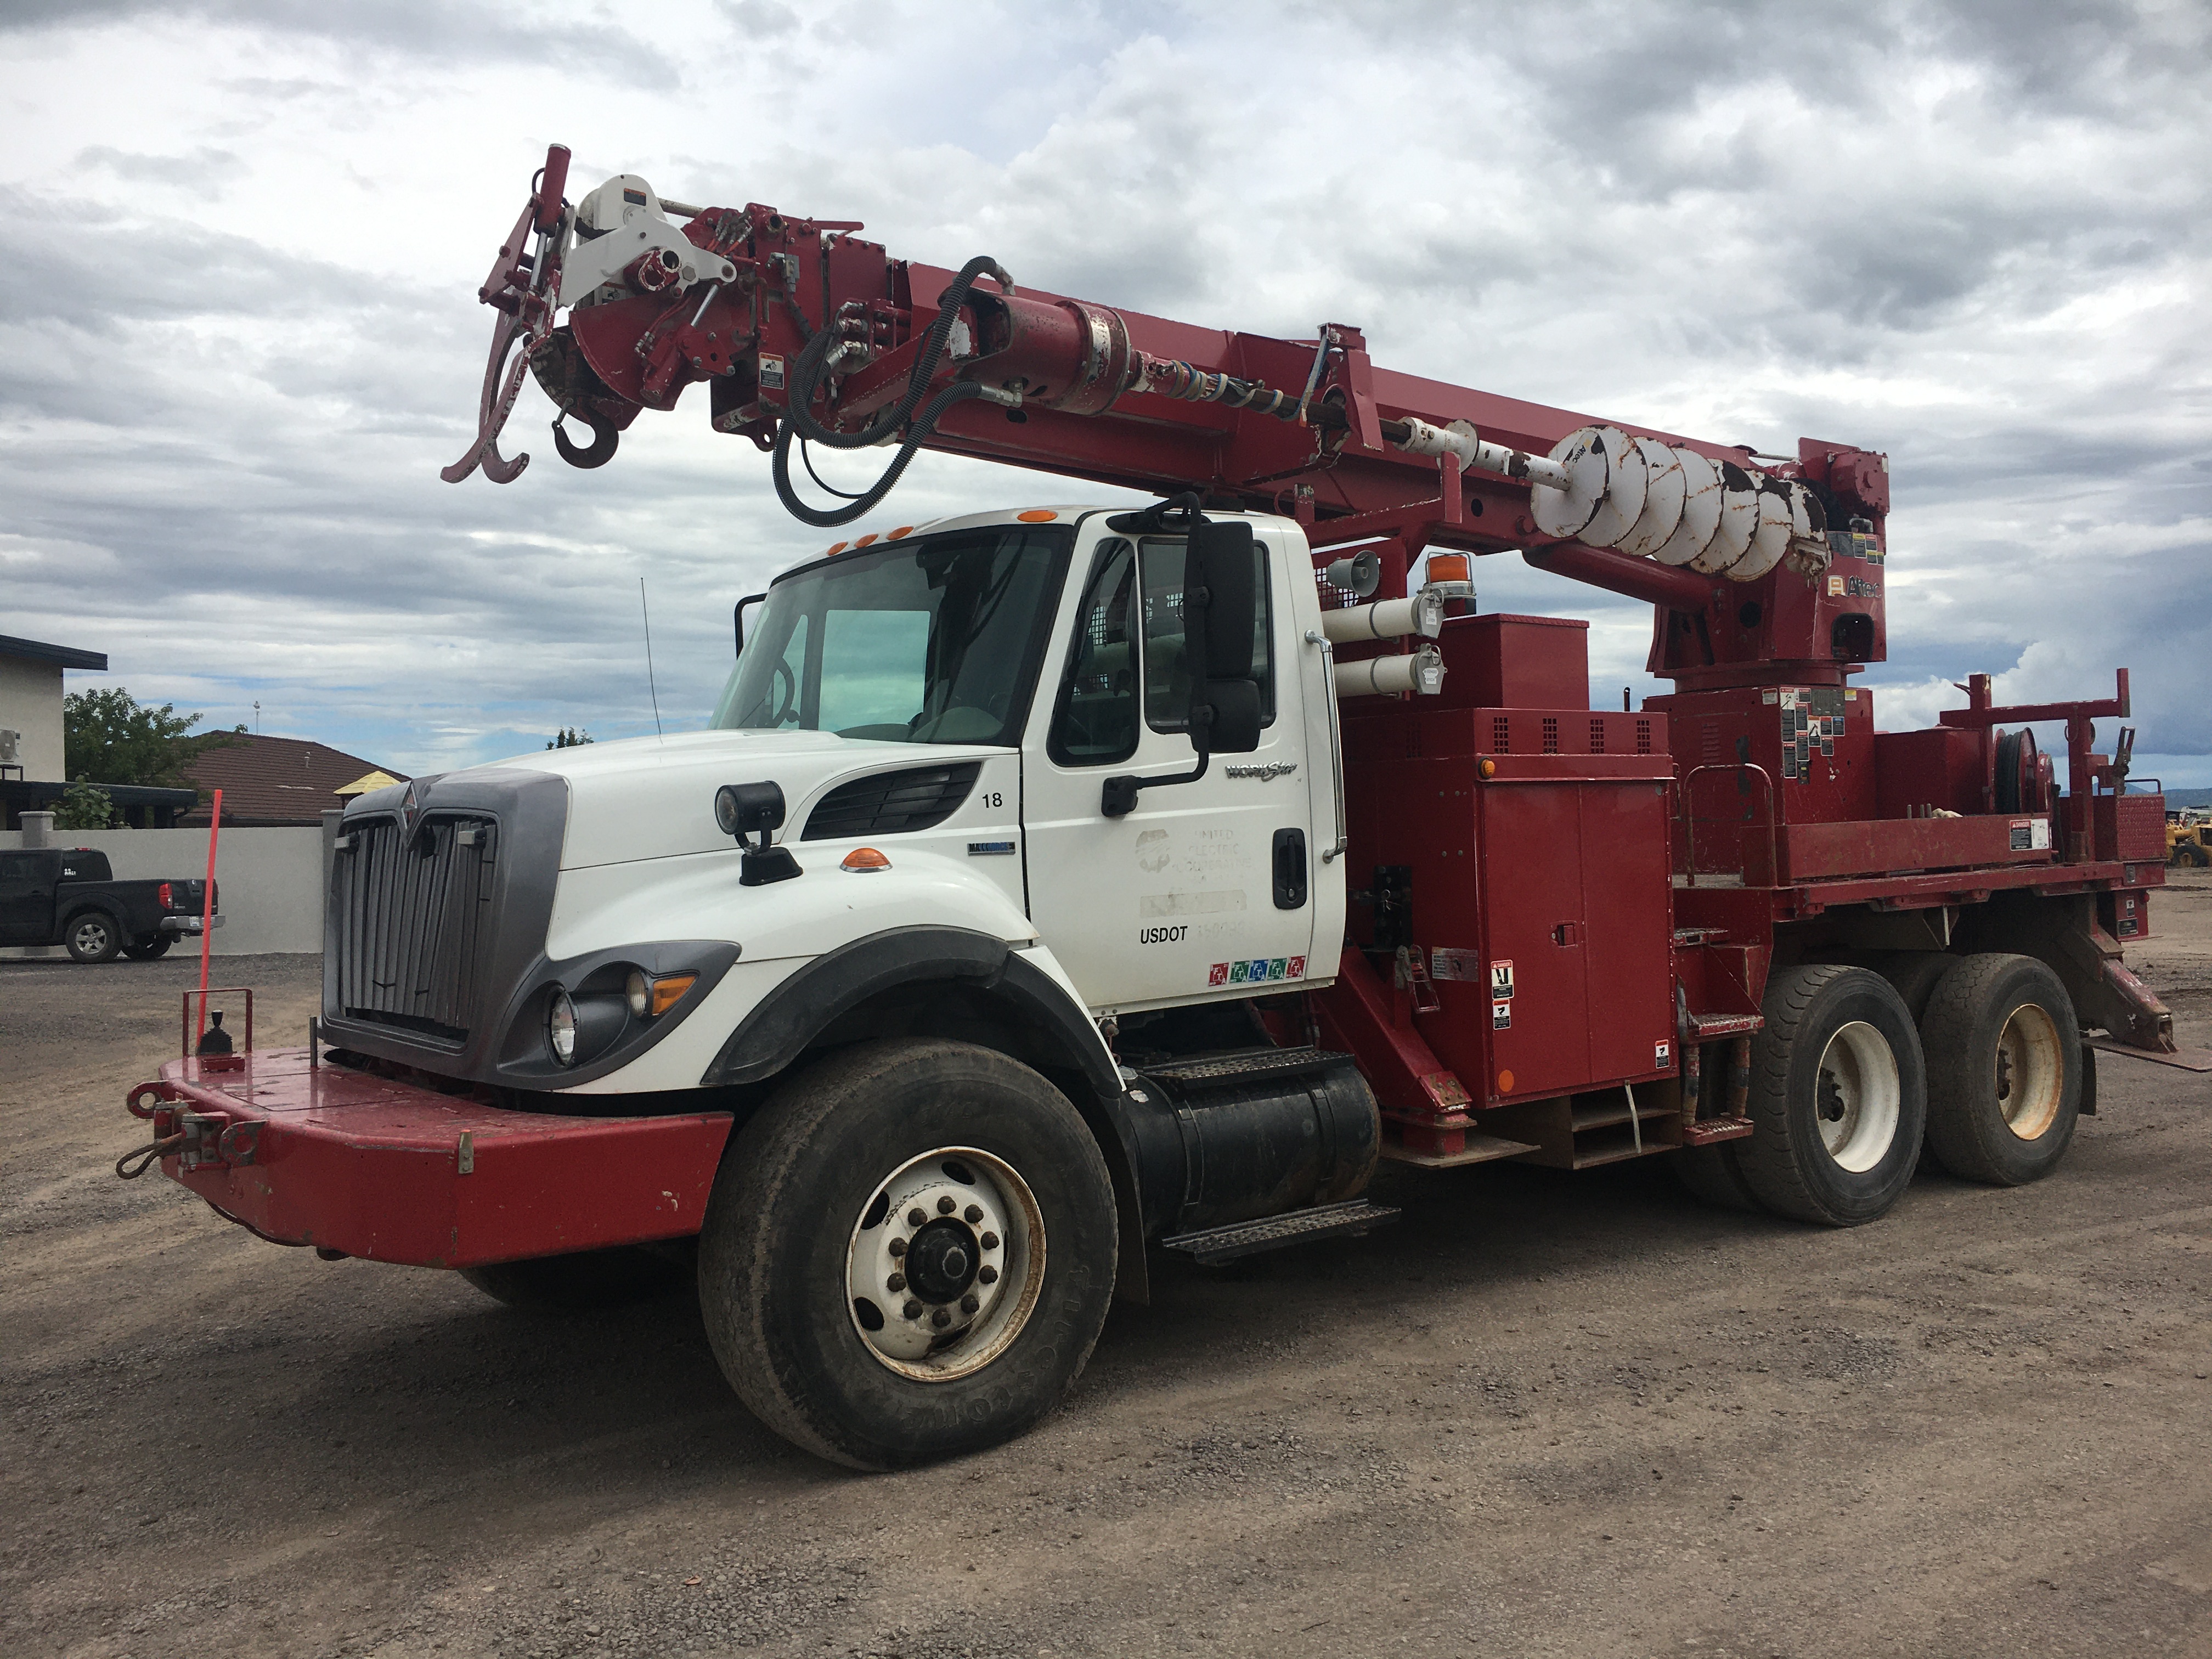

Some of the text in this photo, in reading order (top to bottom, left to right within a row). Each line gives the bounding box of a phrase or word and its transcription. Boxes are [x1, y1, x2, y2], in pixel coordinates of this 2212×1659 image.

[1572, 445, 1586, 464] Altec
[1847, 575, 1882, 599] Altec
[982, 792, 1003, 809] 18
[1141, 926, 1188, 944] USDOT
